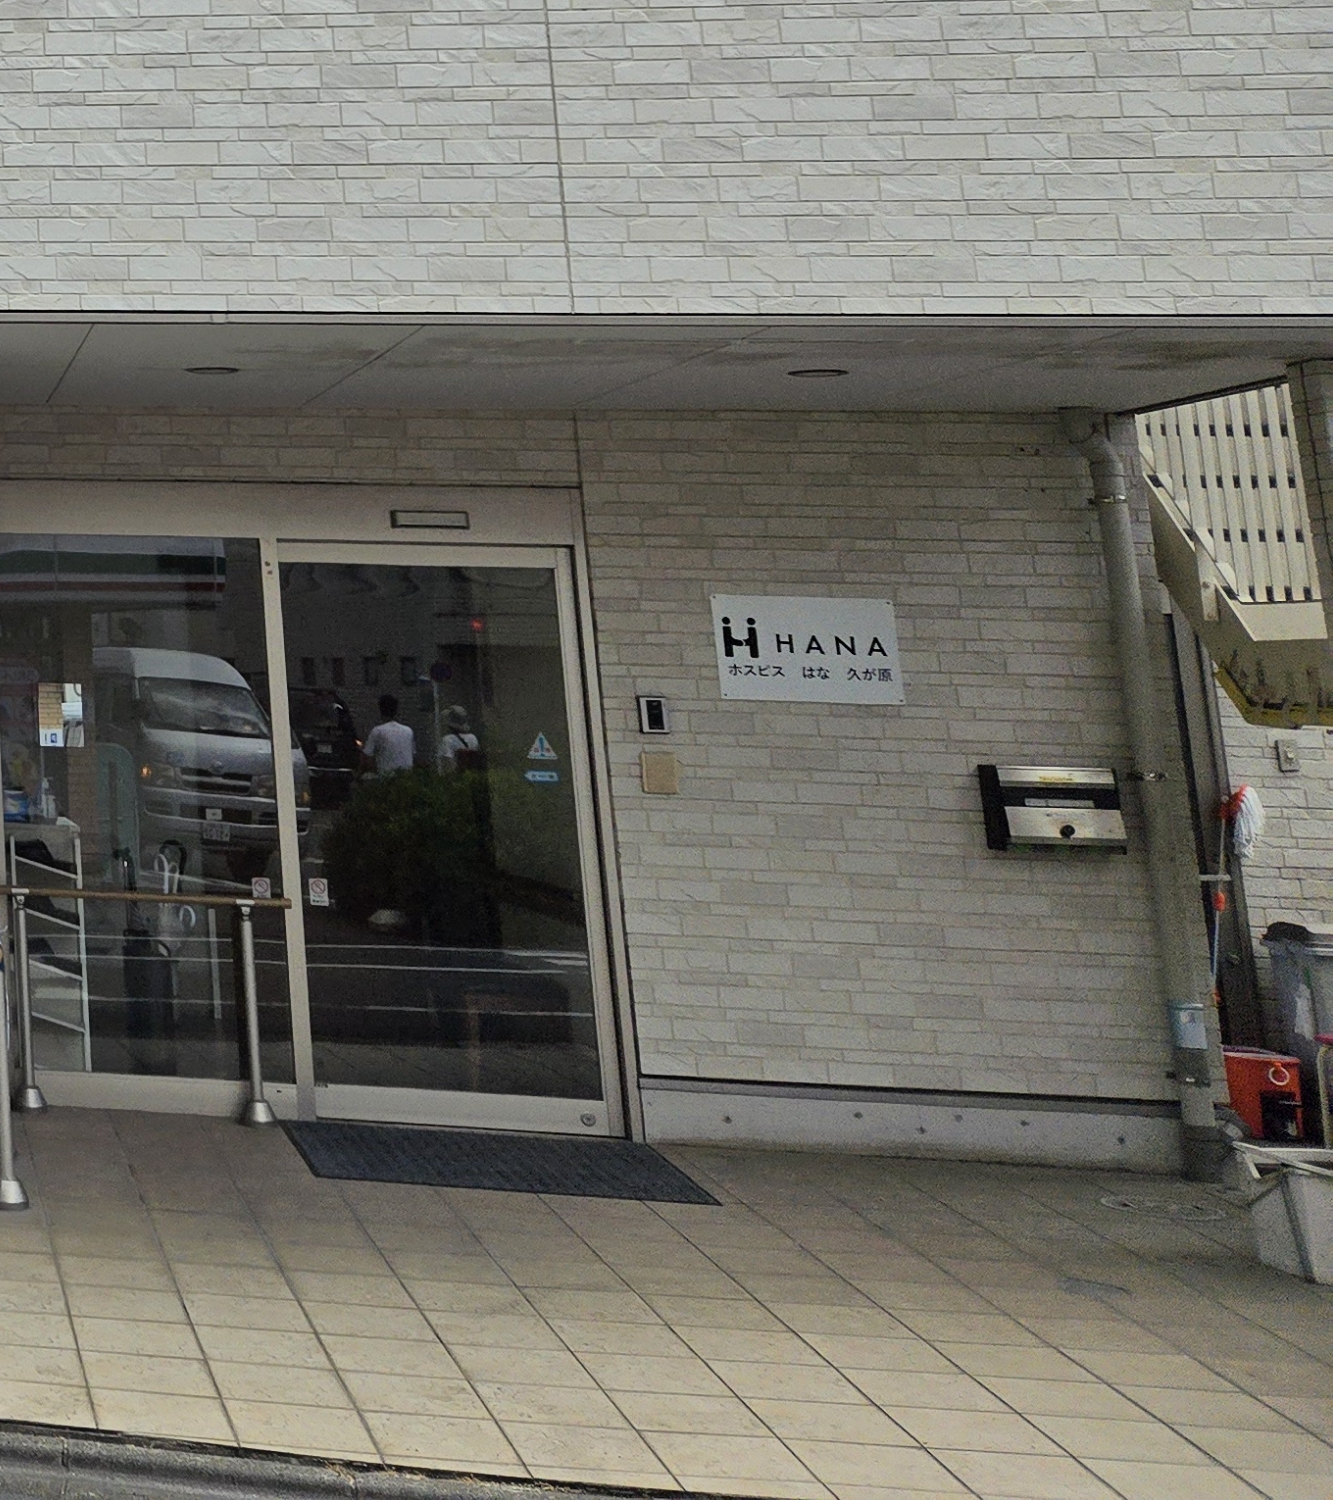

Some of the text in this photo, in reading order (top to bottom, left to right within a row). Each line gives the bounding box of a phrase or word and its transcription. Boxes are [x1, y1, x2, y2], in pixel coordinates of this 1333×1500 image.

[775, 633, 888, 657] HANA
[728, 664, 894, 683] ホスピス はな 久が原
